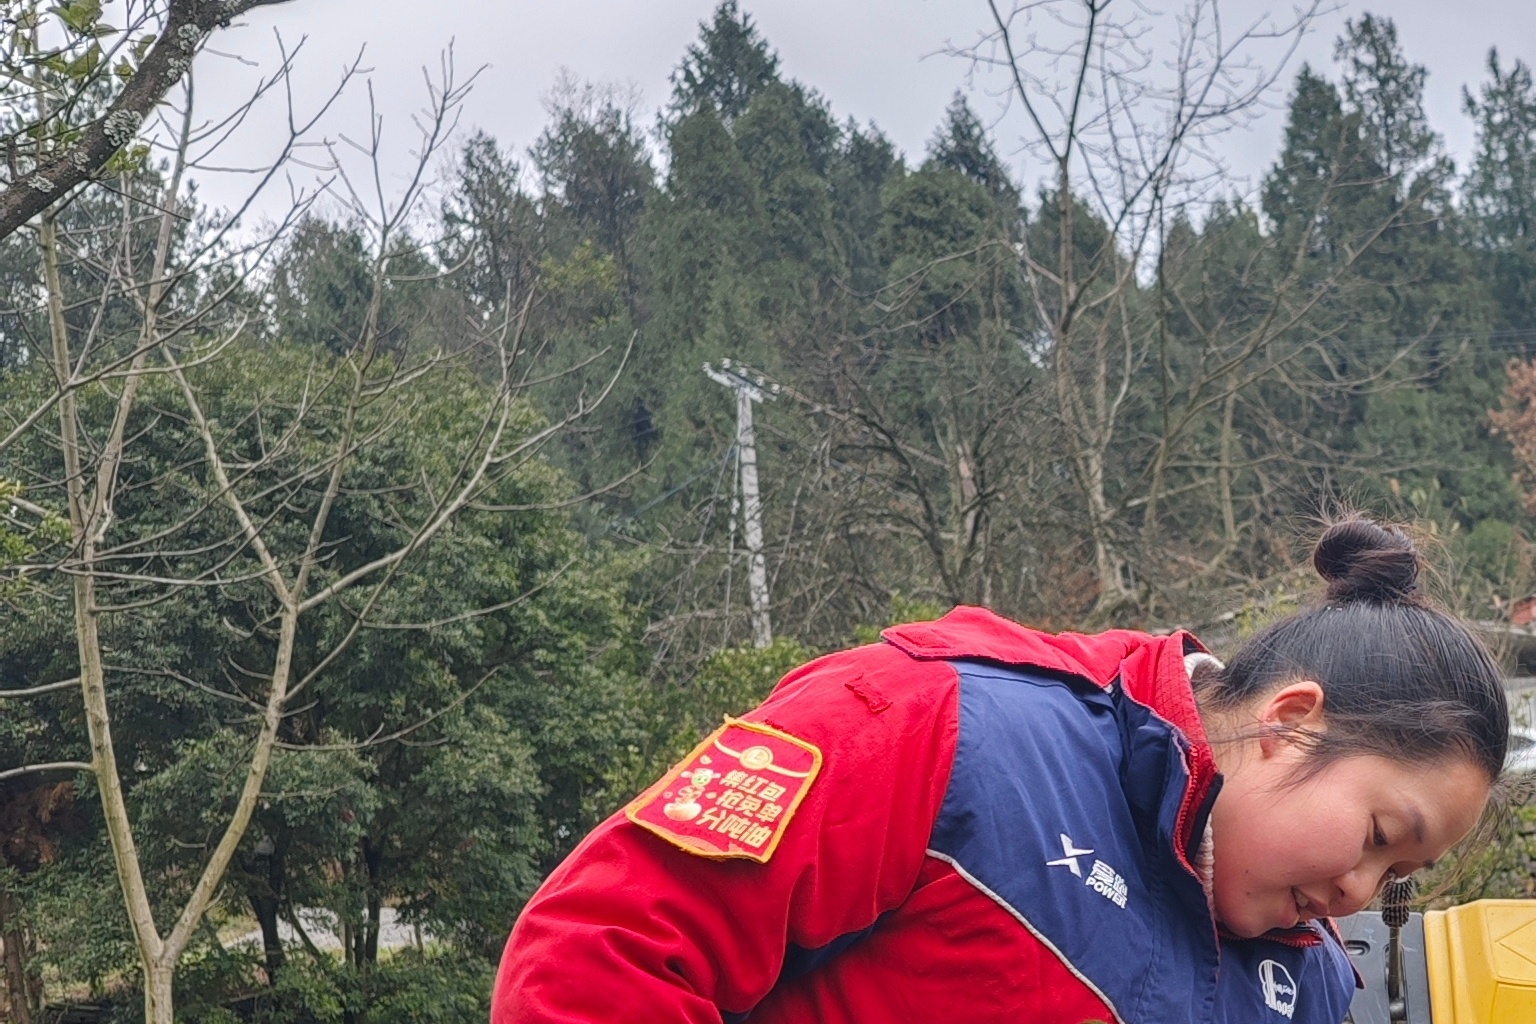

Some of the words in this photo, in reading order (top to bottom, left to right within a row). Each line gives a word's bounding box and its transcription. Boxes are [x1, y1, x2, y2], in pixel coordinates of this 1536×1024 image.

[715, 789, 784, 823] 抢免单
[695, 807, 773, 848] 分吨油
[1085, 876, 1127, 909] POWER
